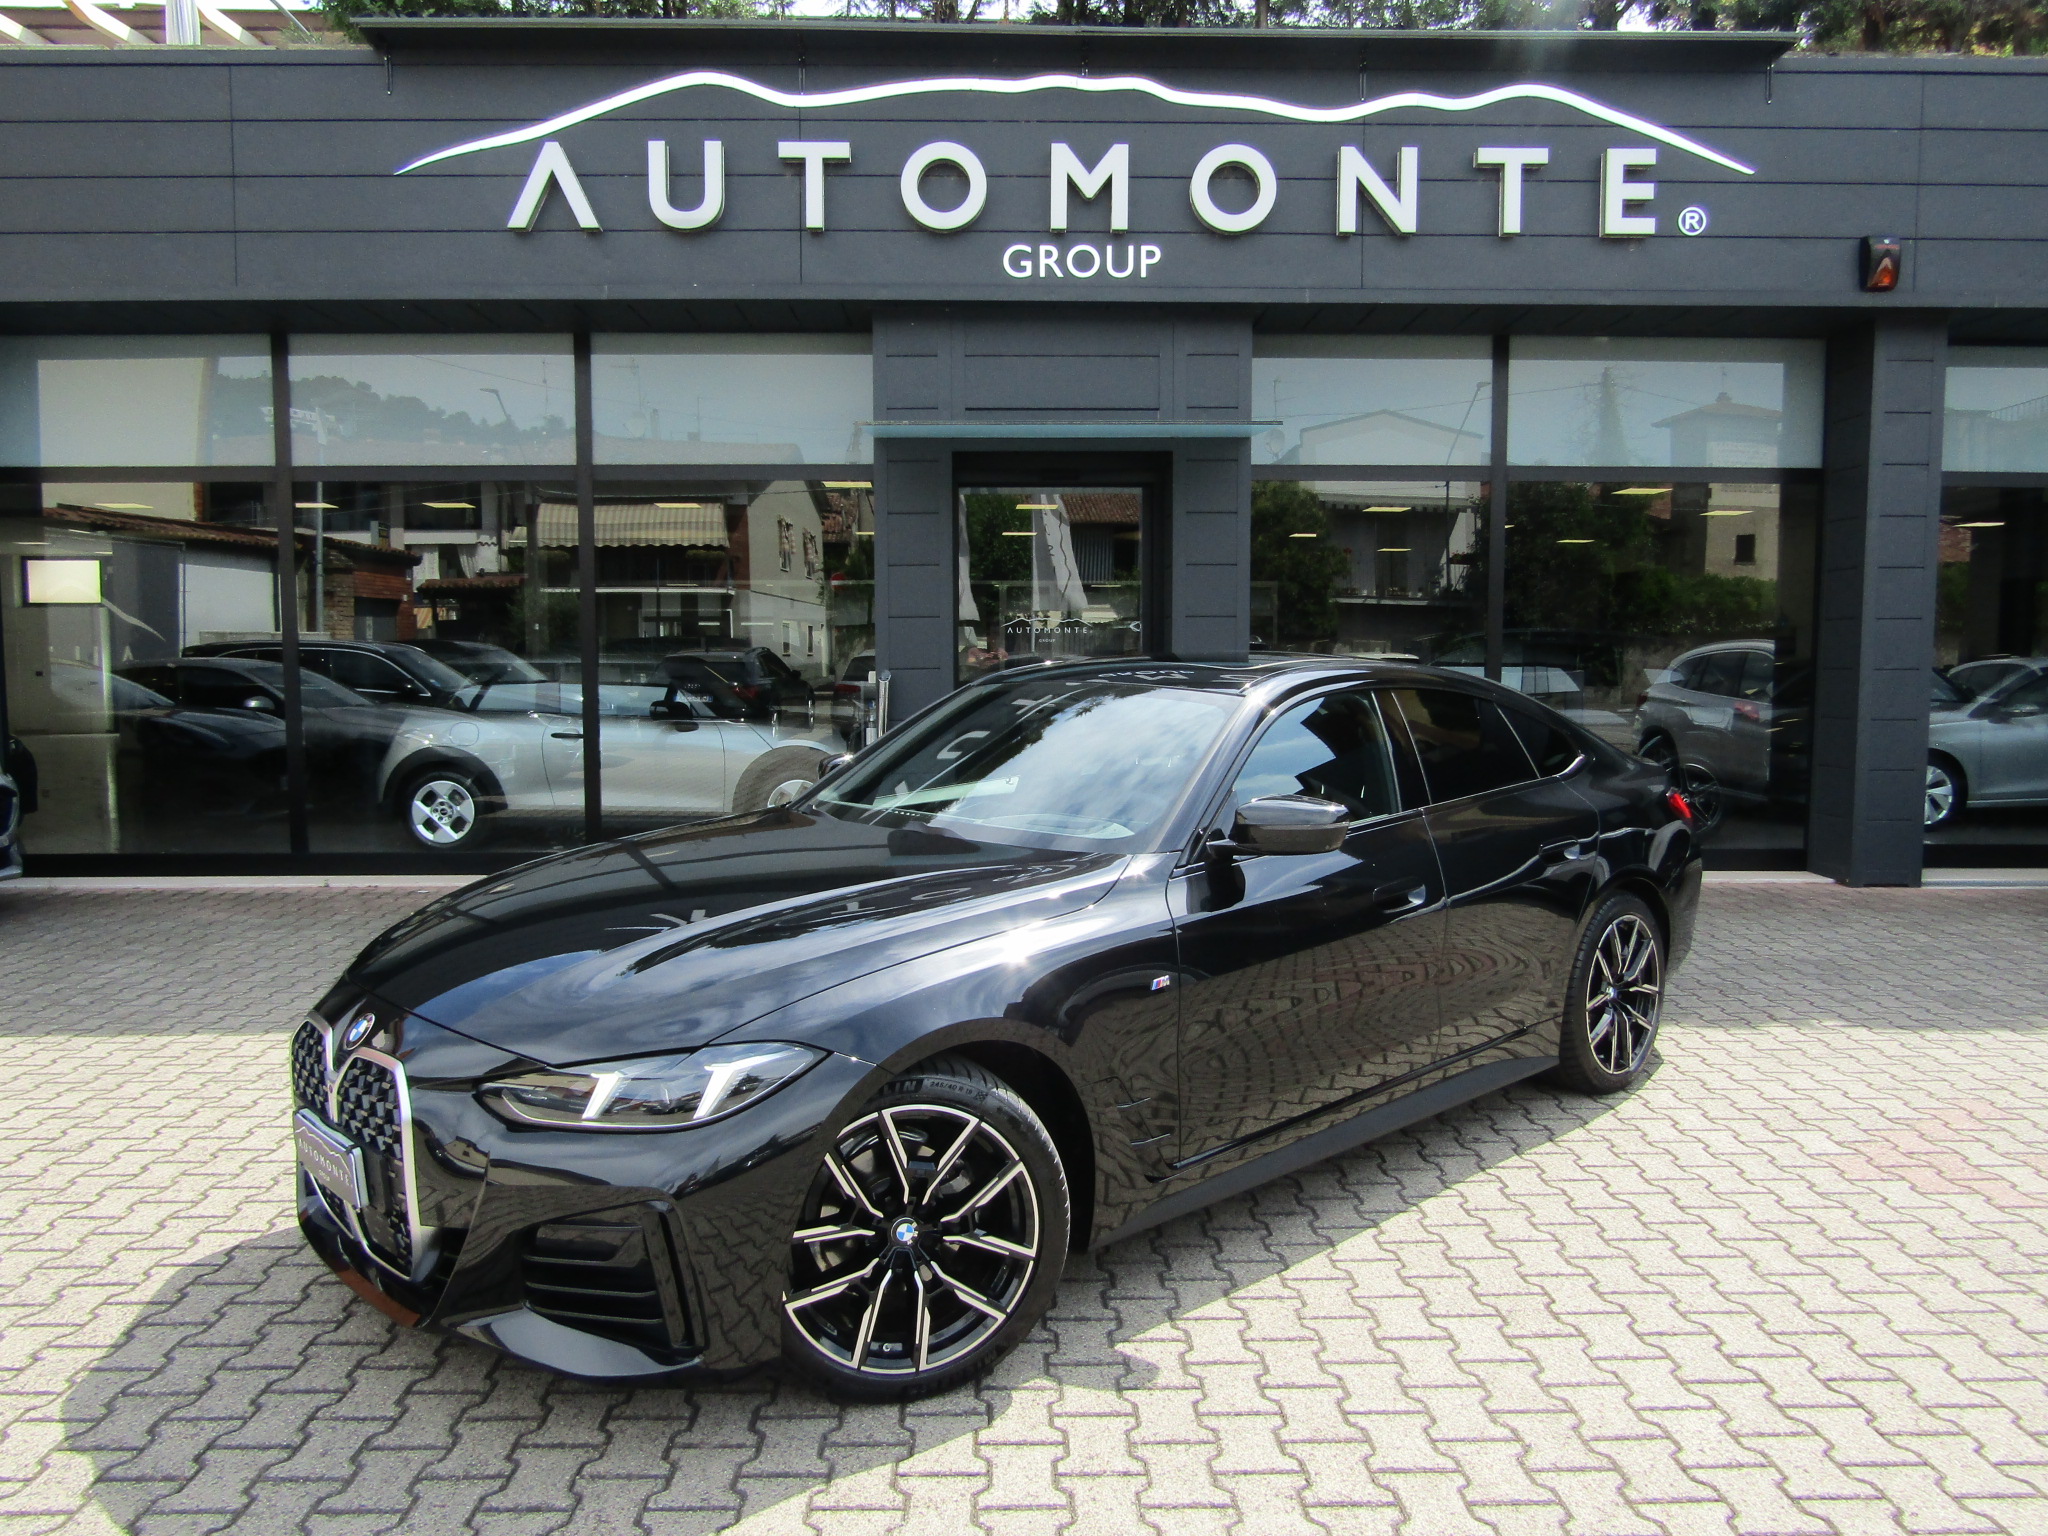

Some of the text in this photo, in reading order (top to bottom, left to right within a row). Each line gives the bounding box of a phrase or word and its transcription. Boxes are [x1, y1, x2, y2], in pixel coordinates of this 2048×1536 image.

[507, 140, 1657, 238] AUTOMONTE
[1002, 244, 1162, 278] GROUP
[1006, 626, 1088, 634] AUTOMONTE
[299, 1138, 350, 1186] AUTOMONTE
